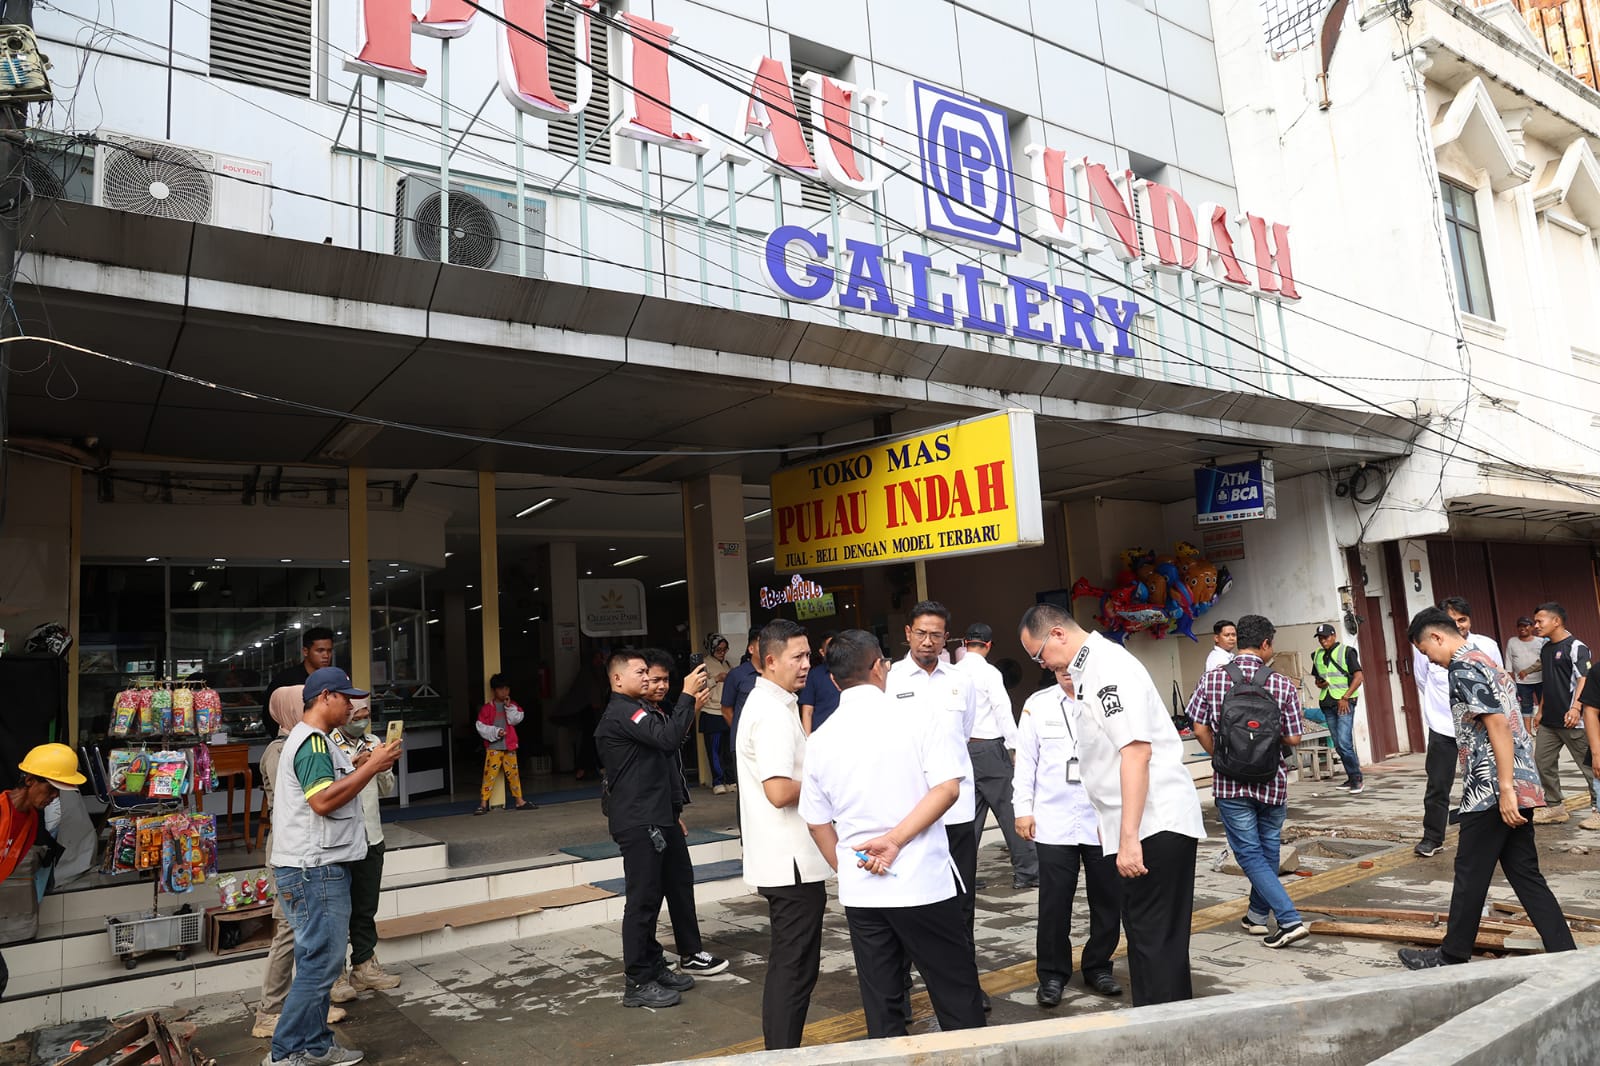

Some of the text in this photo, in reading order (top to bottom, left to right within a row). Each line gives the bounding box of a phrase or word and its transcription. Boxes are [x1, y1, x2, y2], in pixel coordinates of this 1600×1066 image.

[222, 164, 263, 177] POLYTRON
[1024, 143, 1302, 304] INDAH
[762, 225, 1139, 360] GALLERY
[809, 434, 951, 490] TOKO MAS
[1221, 471, 1250, 487] ATM
[777, 460, 1009, 545] PULAU INDAH
[1231, 485, 1258, 502] BCA
[785, 552, 808, 567] JUAL
[816, 547, 838, 564] BELI
[843, 540, 887, 560] DENGAN
[893, 534, 934, 554] MODEL
[938, 524, 1000, 548] TERBARU
